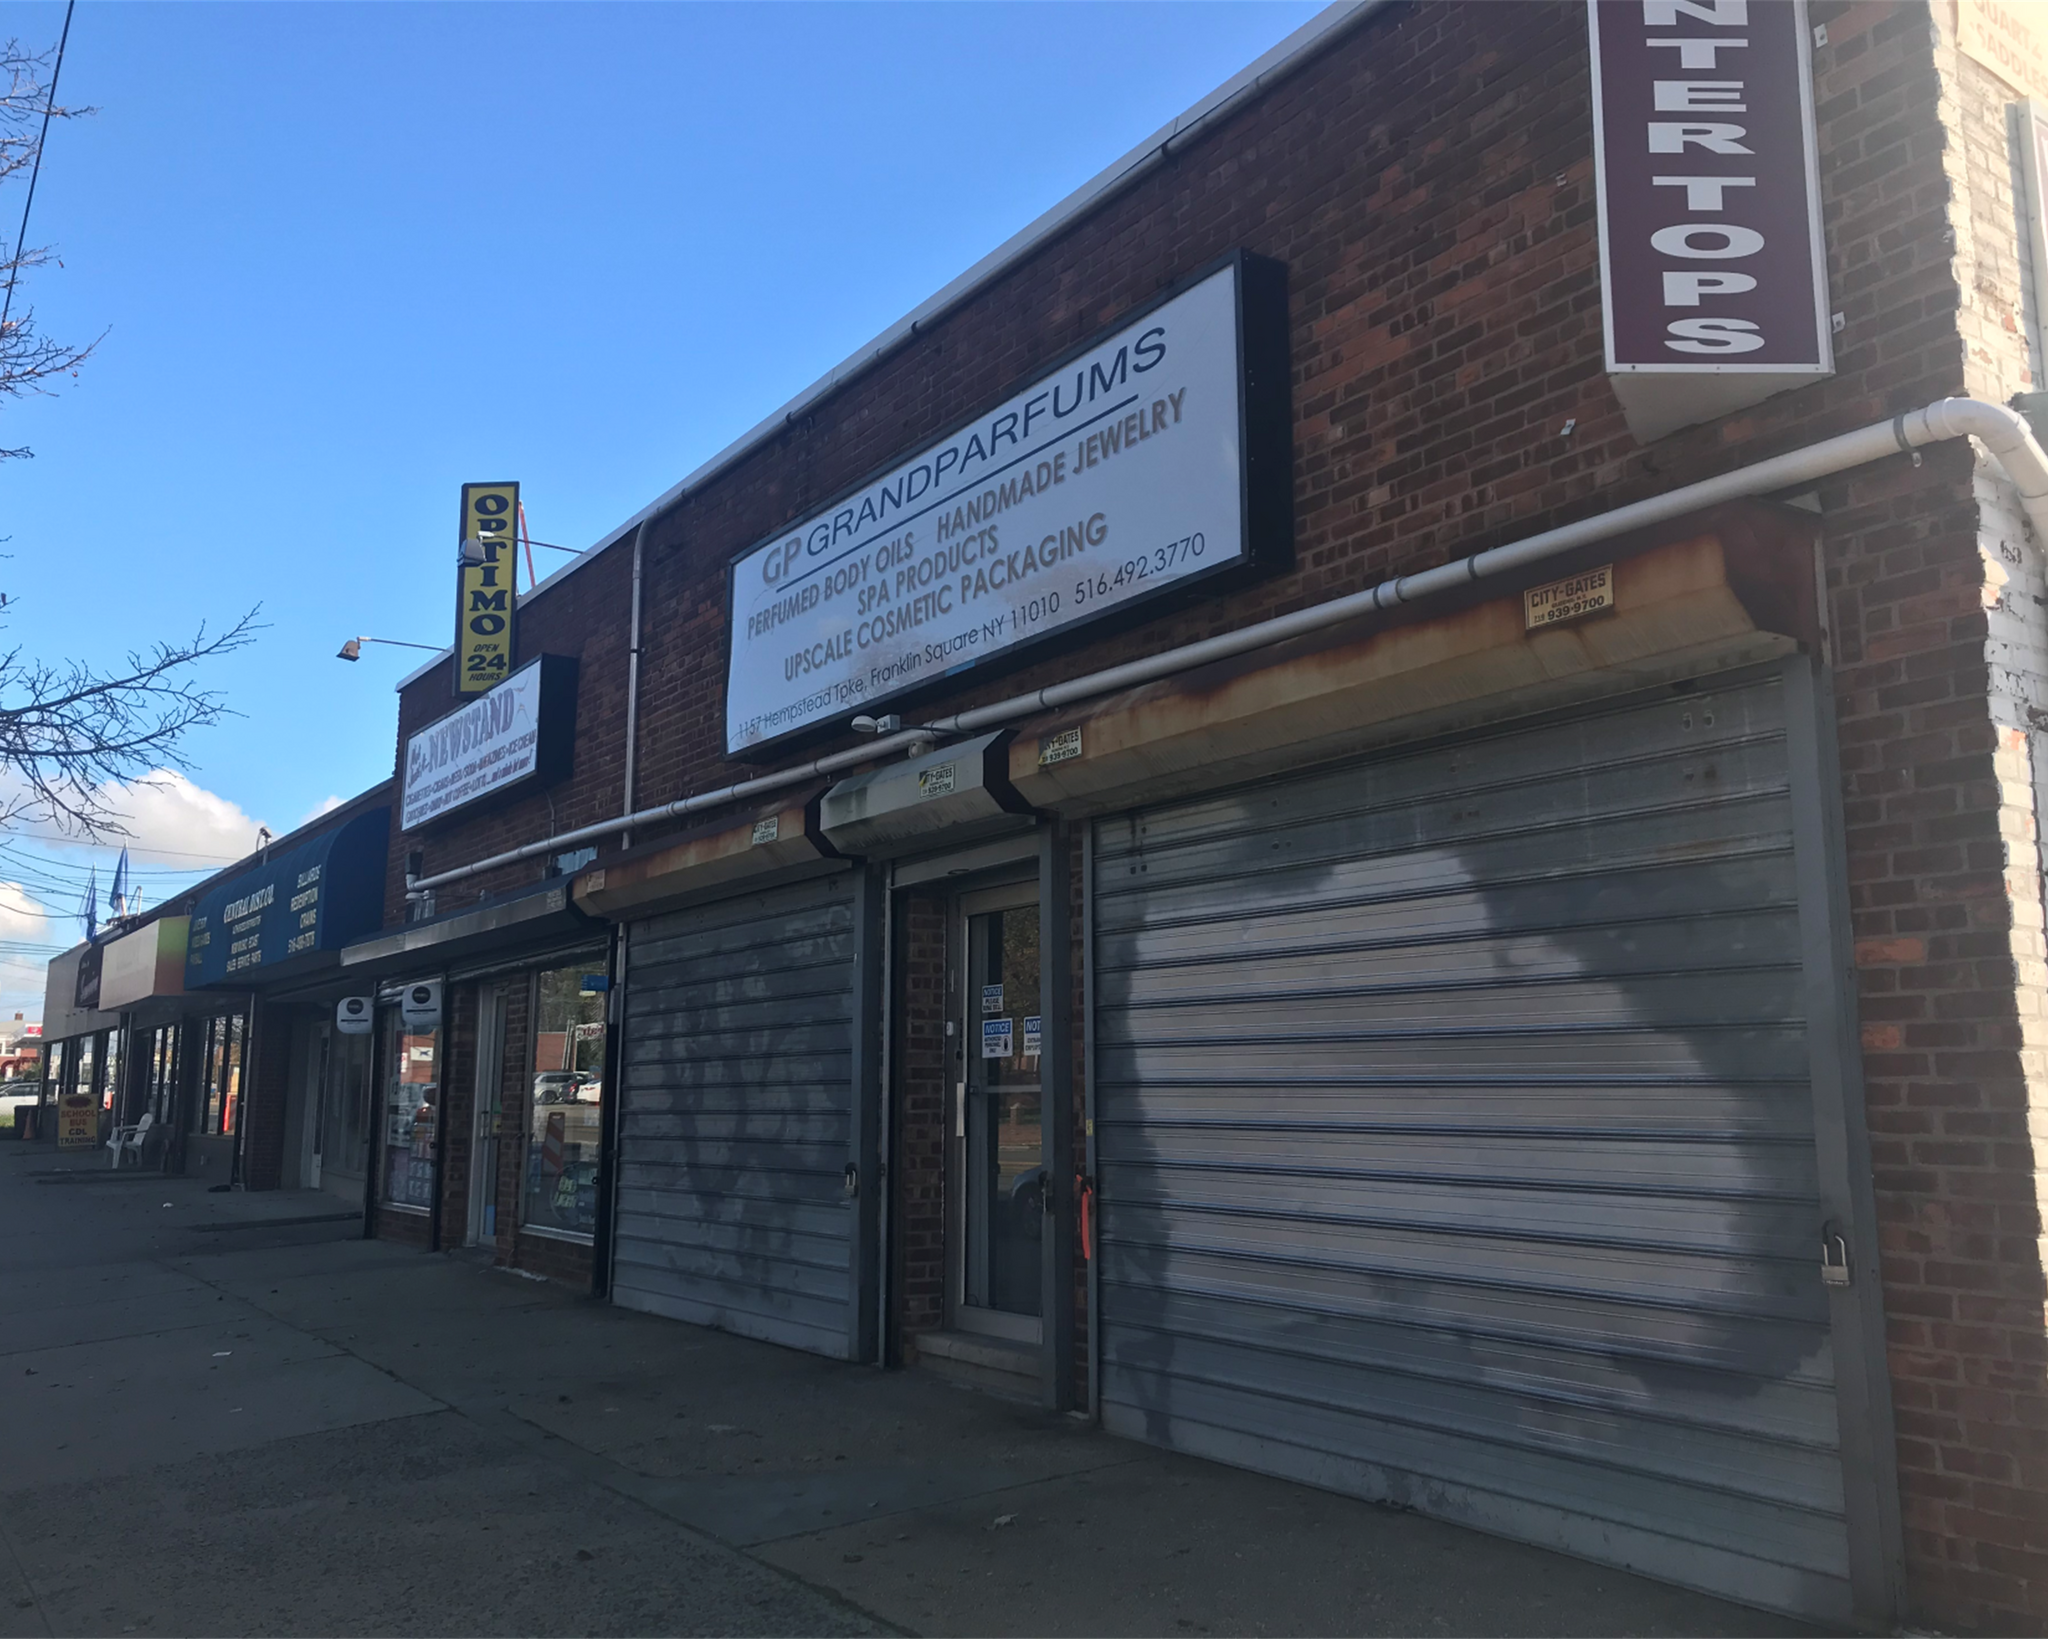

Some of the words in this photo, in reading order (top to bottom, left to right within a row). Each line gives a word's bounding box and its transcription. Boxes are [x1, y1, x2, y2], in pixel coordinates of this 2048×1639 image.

[762, 536, 802, 587] GP
[806, 326, 1168, 556] GRANDPARFUMS
[747, 583, 820, 641] PERFUMED
[824, 554, 870, 602] BODY
[875, 531, 915, 574] OILS
[936, 451, 1067, 543] HANDMADE
[1072, 386, 1187, 476] JEWELRY
[469, 494, 510, 636] OPTIMO
[857, 579, 891, 616] SPA
[895, 524, 1000, 598] PRODUCTS
[784, 629, 853, 682] UPSCALE
[857, 584, 953, 649] COSMETIC
[960, 511, 1109, 604] PACKAGING
[1531, 572, 1607, 608] CITY-GATES
[473, 643, 500, 653] OPEN
[738, 715, 762, 740] 1157
[764, 689, 832, 728] Hempstead
[834, 677, 868, 702] Tpke,
[870, 651, 922, 688] Franklin
[925, 626, 979, 664] Square
[982, 613, 1005, 639] NY
[1010, 591, 1061, 630] 11010
[1074, 532, 1206, 605] 516.492.3770
[466, 653, 507, 672] 24
[468, 672, 503, 682] HOURS
[428, 687, 515, 774] NEWSTAND
[984, 988, 1001, 996] NOTICE
[985, 1023, 1009, 1033] NOTICE
[61, 1109, 96, 1118] SCHOOL
[69, 1118, 87, 1126] BUS
[60, 1136, 96, 1145] TRAINING
